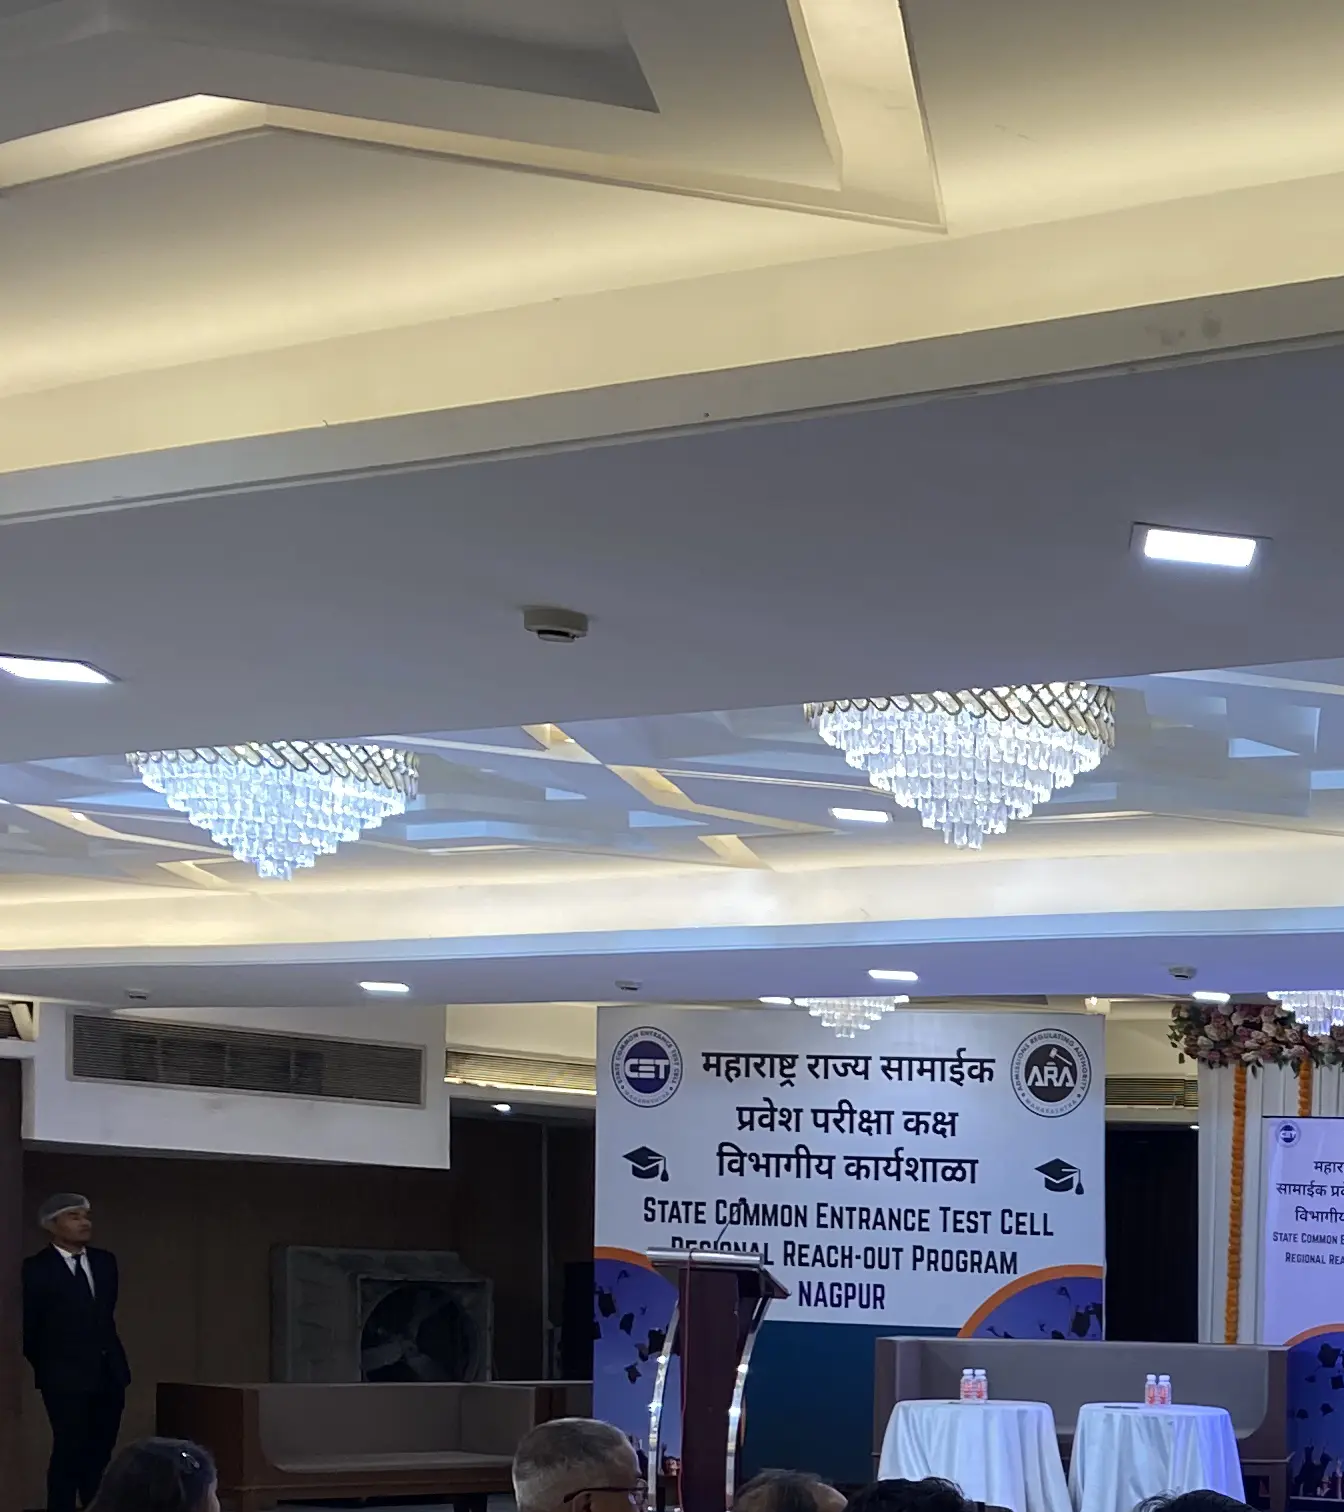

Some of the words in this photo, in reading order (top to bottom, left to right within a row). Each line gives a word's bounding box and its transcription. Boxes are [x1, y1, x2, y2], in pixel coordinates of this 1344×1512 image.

[700, 1049, 800, 1089] महाराष्ट्र
[806, 1051, 873, 1082] राज्य
[879, 1047, 996, 1085] सामाईक
[1027, 1061, 1075, 1088] ARA
[735, 1096, 803, 1135] प्रवेश
[811, 1098, 896, 1136] परीक्षा
[902, 1109, 960, 1139] कक्ष
[714, 1141, 835, 1180] विभागीय
[842, 1146, 980, 1185] कार्यशाळा
[1276, 1180, 1328, 1199] सामाईक
[643, 1196, 707, 1224] STATE
[715, 1198, 808, 1228] COMMON
[816, 1202, 931, 1233] ENTRANCE
[939, 1205, 992, 1235] TEST
[1000, 1208, 1054, 1237] CELL
[1272, 1231, 1298, 1243] STATE
[1301, 1232, 1338, 1245] COMMON
[783, 1239, 905, 1272] REACH-OUT
[911, 1243, 1019, 1275] PROGRAM
[1285, 1252, 1327, 1265] REGIONAL
[798, 1280, 886, 1310] NAGPUR
